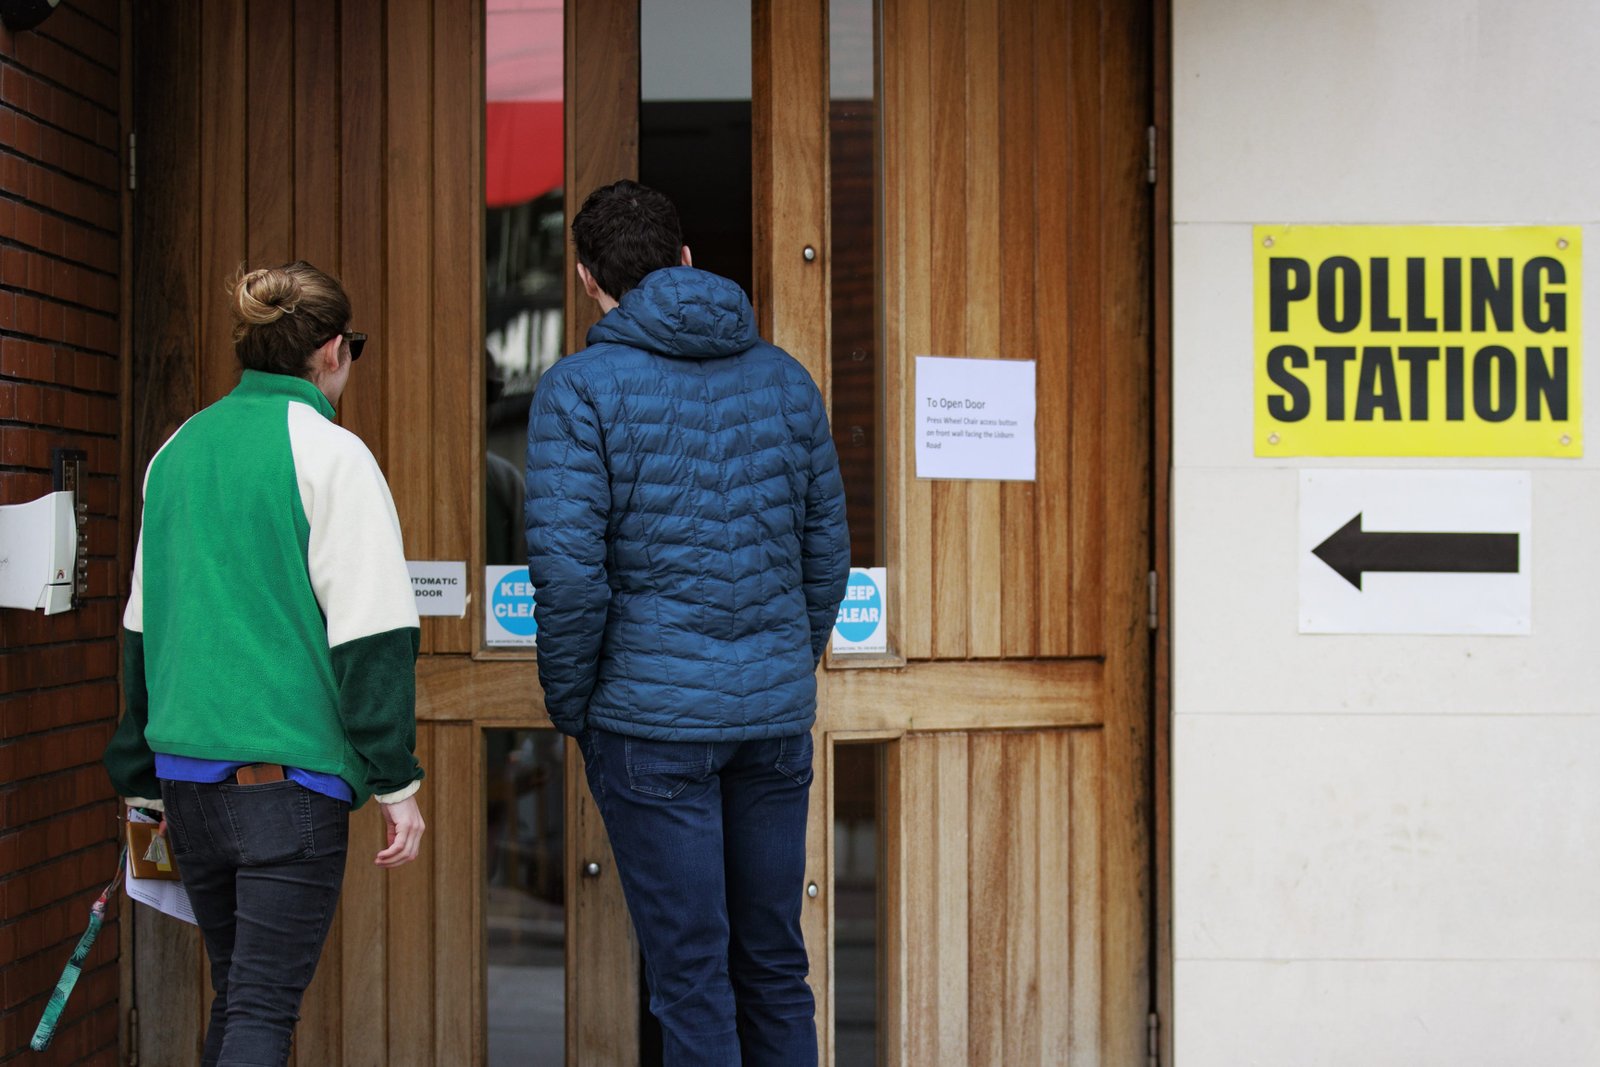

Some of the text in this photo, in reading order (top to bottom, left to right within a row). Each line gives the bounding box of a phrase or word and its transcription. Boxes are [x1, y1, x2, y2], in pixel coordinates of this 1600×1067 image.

[1269, 256, 1567, 333] POLLING
[1266, 345, 1568, 422] STATION
[927, 397, 986, 410] To Open Door
[944, 417, 962, 425] Wheel
[963, 417, 978, 425] Chair
[965, 431, 982, 439] facing
[411, 577, 457, 585] TOMATIC
[501, 582, 536, 597] KEE
[844, 585, 875, 600] EEP
[495, 604, 534, 618] CLE
